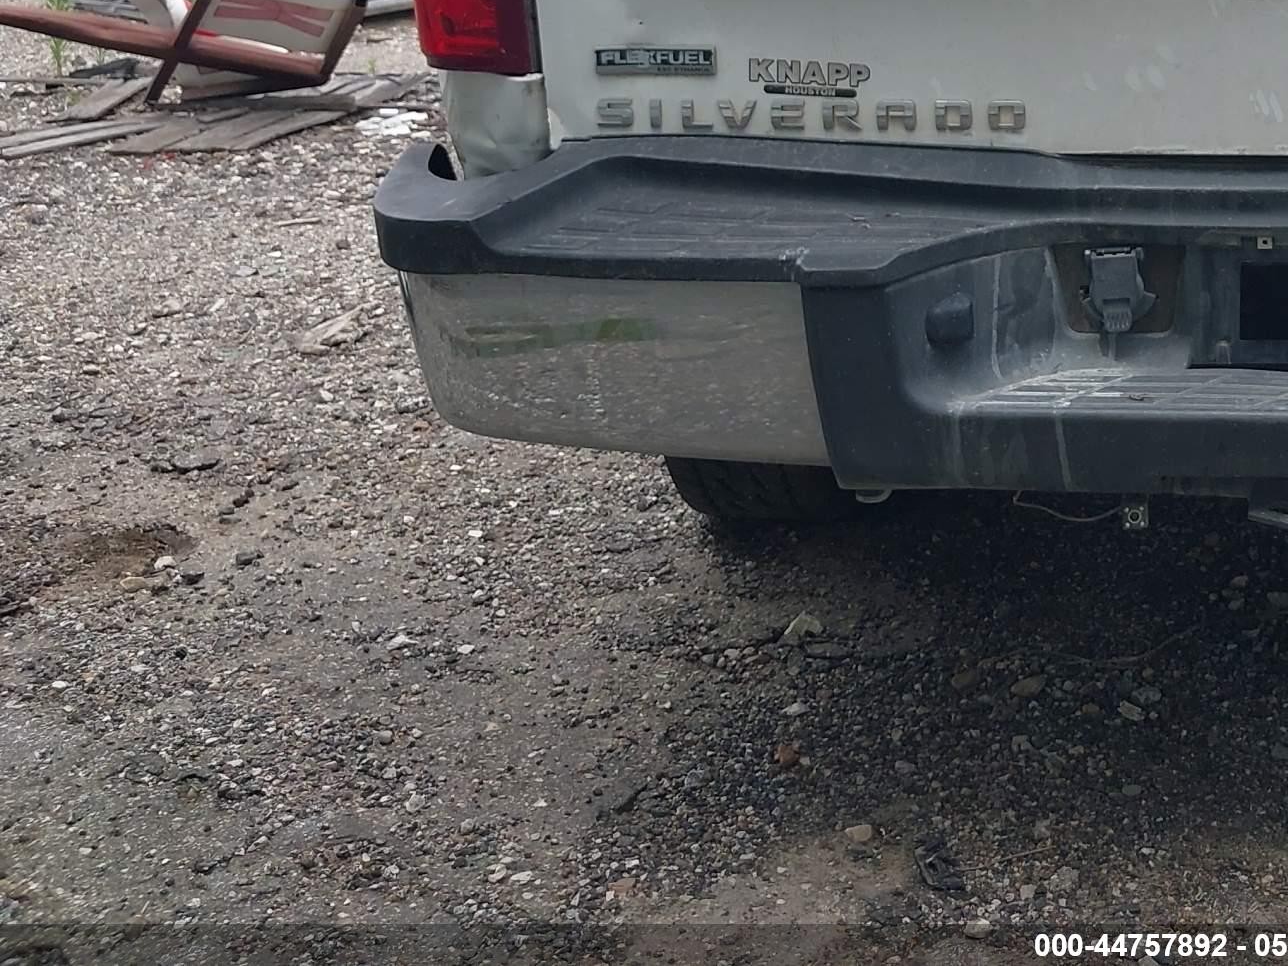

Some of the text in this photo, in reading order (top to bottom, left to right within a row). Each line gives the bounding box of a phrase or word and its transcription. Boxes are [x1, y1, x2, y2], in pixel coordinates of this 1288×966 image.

[748, 57, 871, 88] KNAPP
[785, 85, 837, 97] HOUSTON
[595, 97, 1028, 131] SILVERADO
